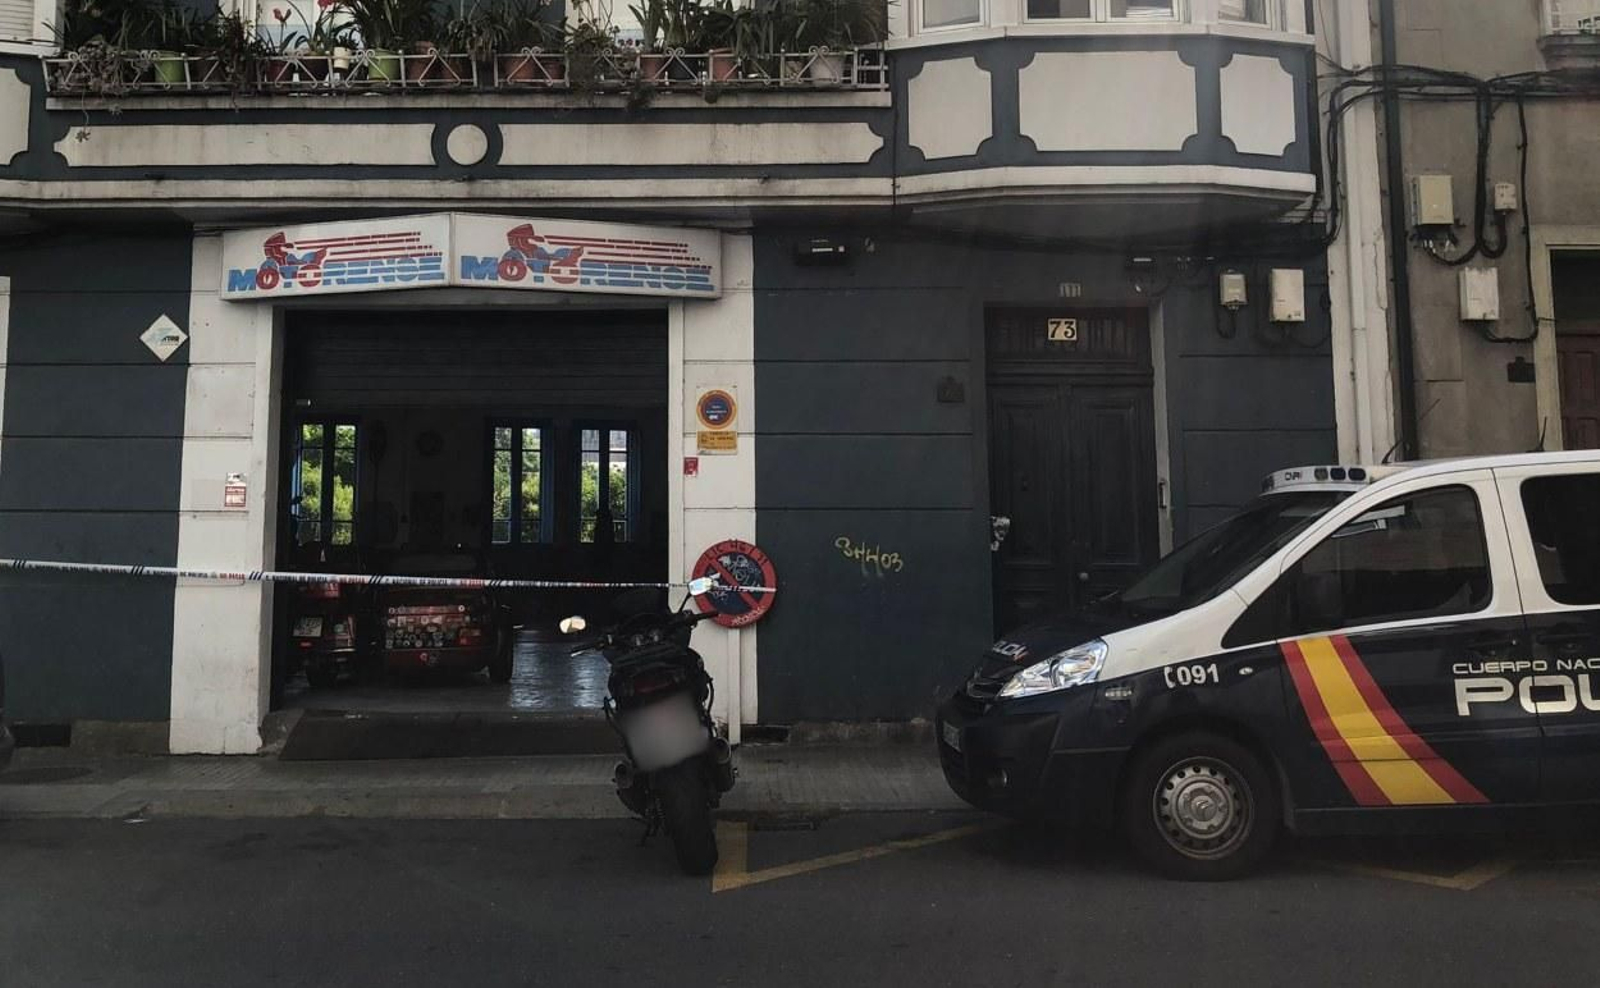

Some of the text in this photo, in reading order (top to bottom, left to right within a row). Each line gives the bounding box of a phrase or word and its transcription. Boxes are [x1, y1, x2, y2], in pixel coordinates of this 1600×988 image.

[1049, 320, 1076, 339] 73
[1176, 663, 1219, 685] 091
[1452, 657, 1600, 674] CUERPO NAC
[1454, 673, 1600, 716] POL
